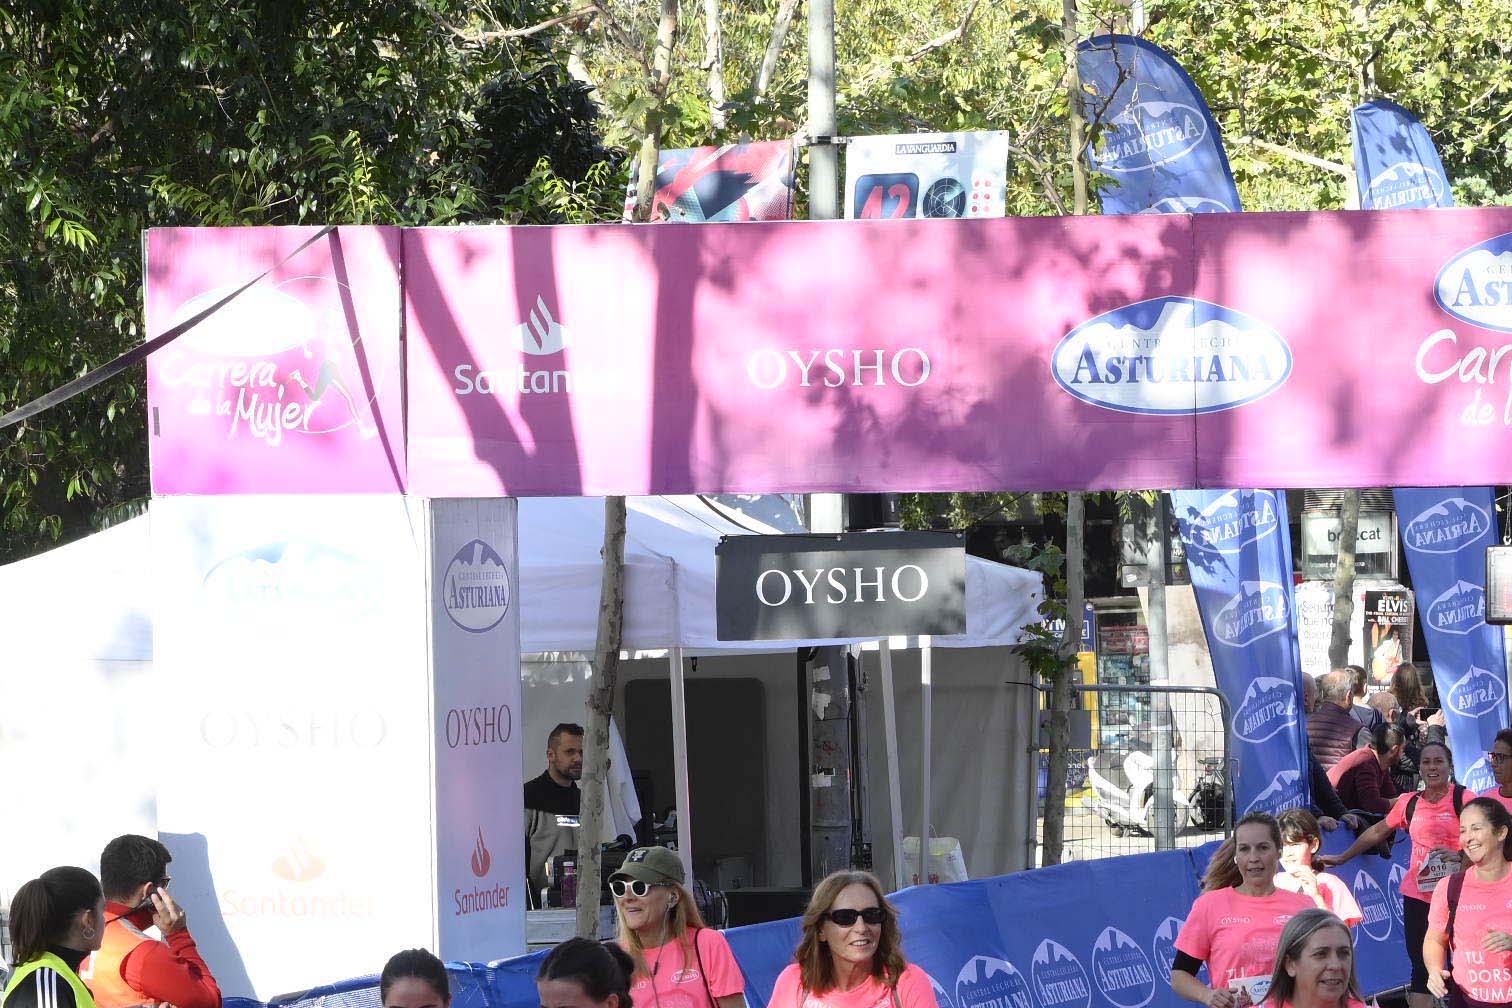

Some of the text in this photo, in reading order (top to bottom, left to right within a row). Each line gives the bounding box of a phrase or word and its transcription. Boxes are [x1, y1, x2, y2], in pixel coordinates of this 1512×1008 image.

[747, 347, 931, 390] OYSHO
[1071, 345, 1273, 387] ASTURIANA
[230, 385, 326, 448] Mujer
[1461, 387, 1494, 426] de
[449, 575, 508, 610] ASTURIANA
[755, 563, 930, 608] OYSHO
[1377, 599, 1408, 612] ELVIS
[445, 704, 513, 749] OYSHO
[455, 883, 511, 917] Santander
[1098, 960, 1153, 992] ASTURIANA
[1465, 951, 1484, 965] TU
[1036, 972, 1089, 1007] ASTURIANA
